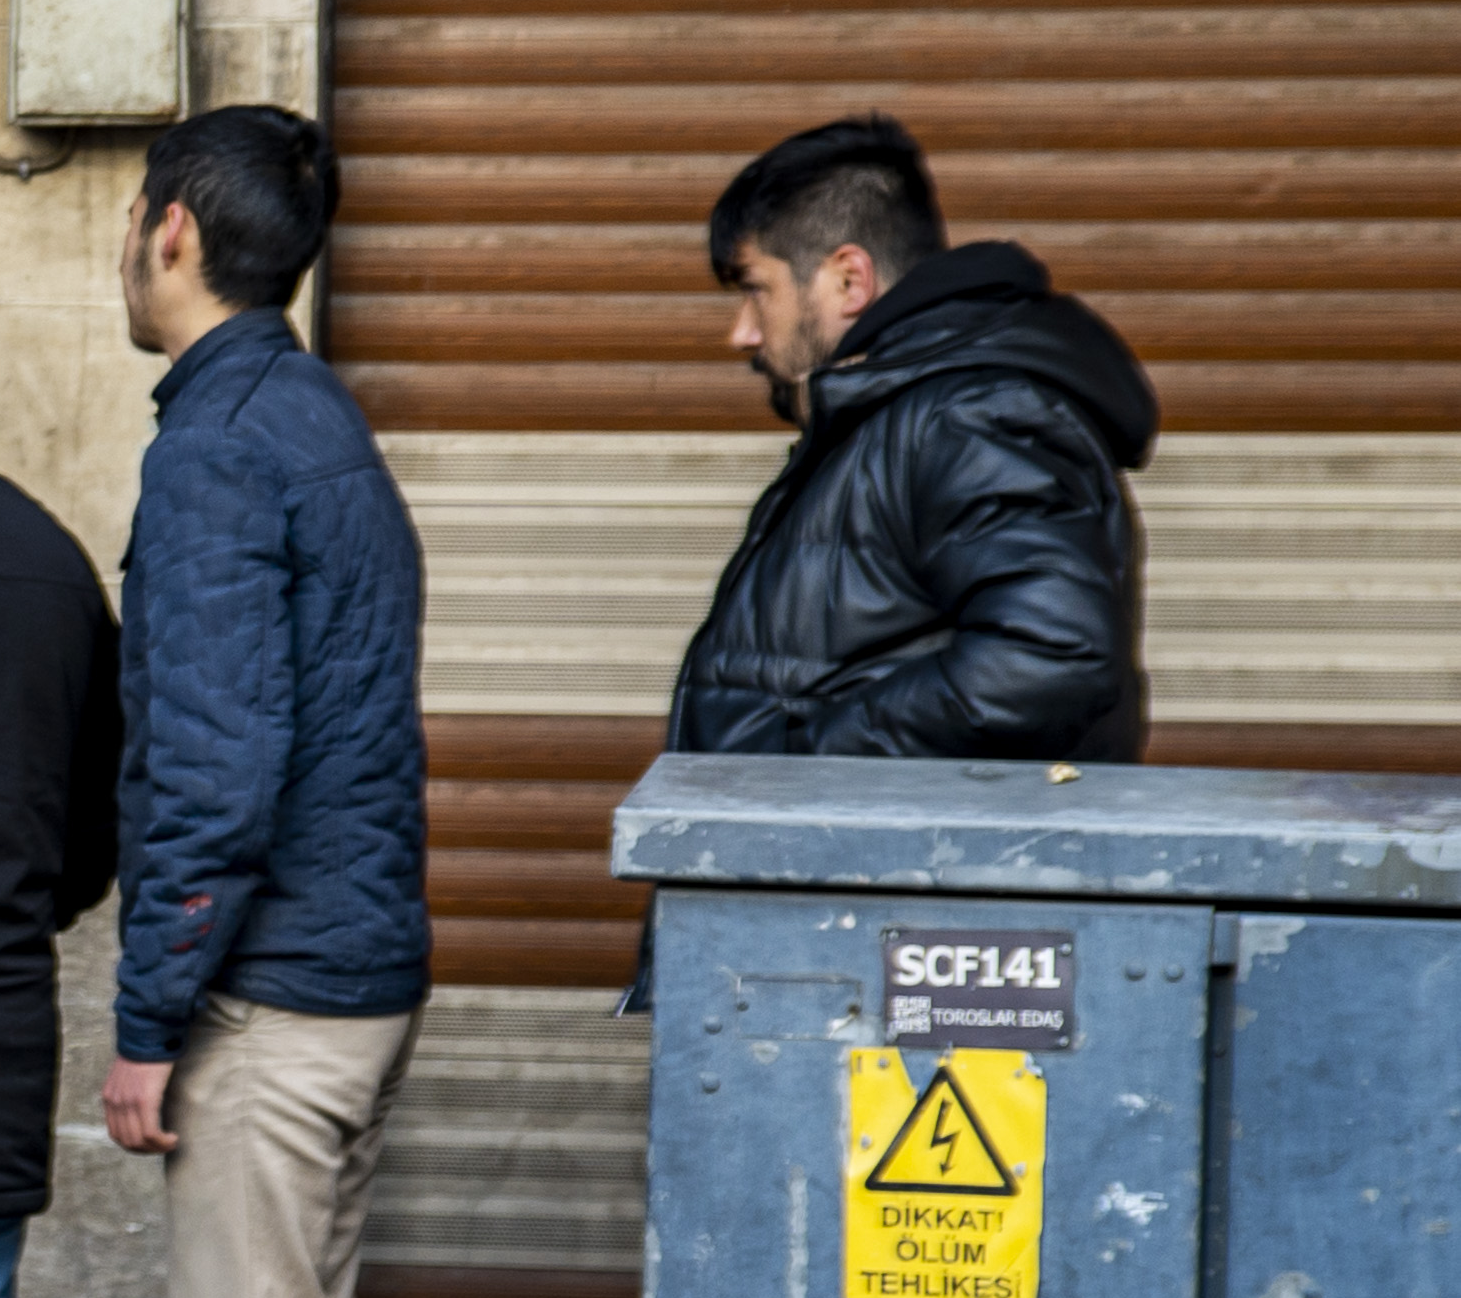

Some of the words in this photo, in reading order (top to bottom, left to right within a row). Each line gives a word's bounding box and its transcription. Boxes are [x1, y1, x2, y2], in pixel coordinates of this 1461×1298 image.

[892, 944, 1061, 988] SCF141
[932, 1007, 1017, 1027] TOROSLAR
[1019, 1008, 1064, 1031] EDAŞ
[882, 1200, 1005, 1233] DİKKAT!
[896, 1232, 986, 1265] ÖLÜM
